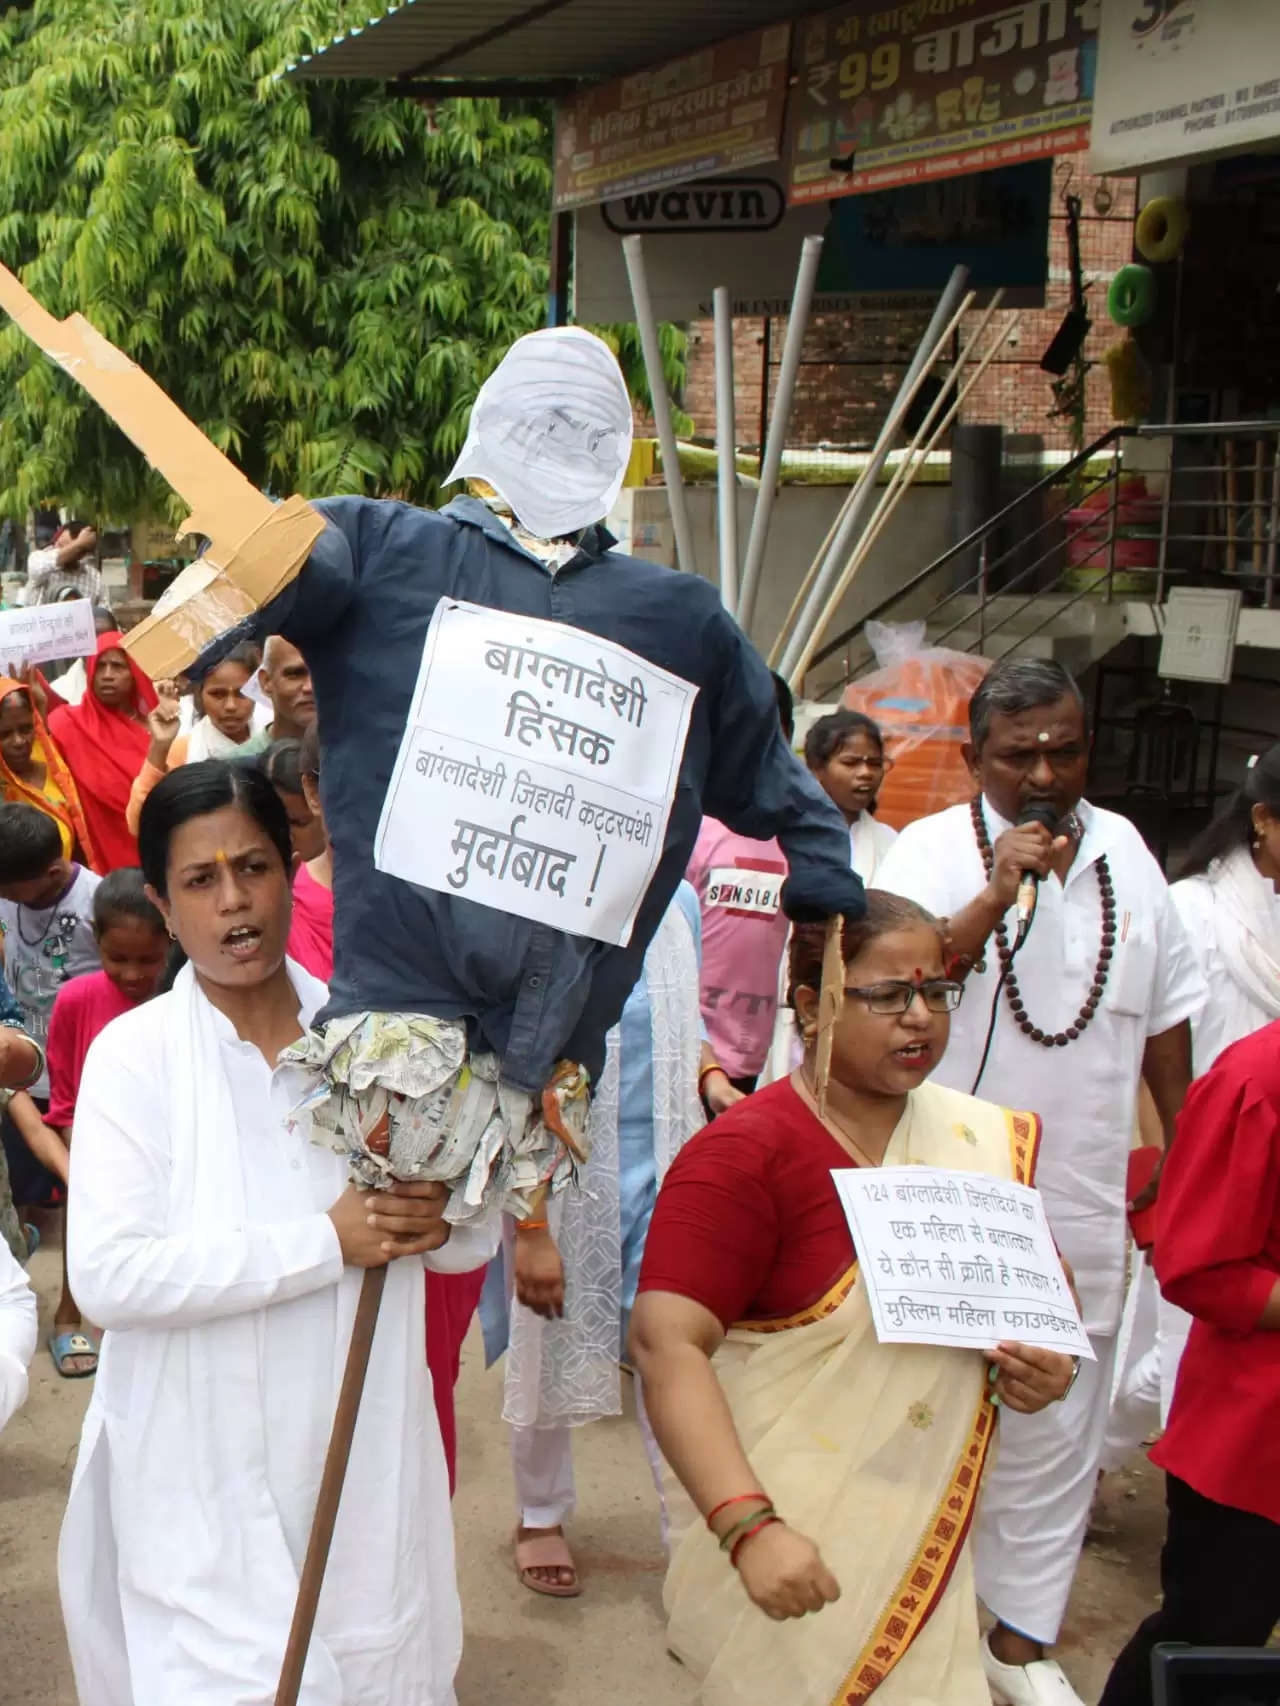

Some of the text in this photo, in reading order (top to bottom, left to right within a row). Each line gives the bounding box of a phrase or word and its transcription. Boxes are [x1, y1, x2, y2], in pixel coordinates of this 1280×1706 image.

[484, 637, 649, 728] बांग्लादेशी
[504, 690, 616, 766] हिंसक
[415, 745, 507, 799] बांग्लादेशी
[510, 768, 575, 820] जिहादी
[446, 814, 577, 899] मुर्दाबाद
[877, 1250, 895, 1278] ये
[898, 1250, 932, 1280] कौन
[934, 1251, 956, 1282] सी
[888, 1219, 917, 1241] एक
[920, 1214, 966, 1244] महिला
[968, 1216, 985, 1244] से
[884, 1295, 941, 1327] मुस्लिम
[947, 1300, 996, 1328] महिला
